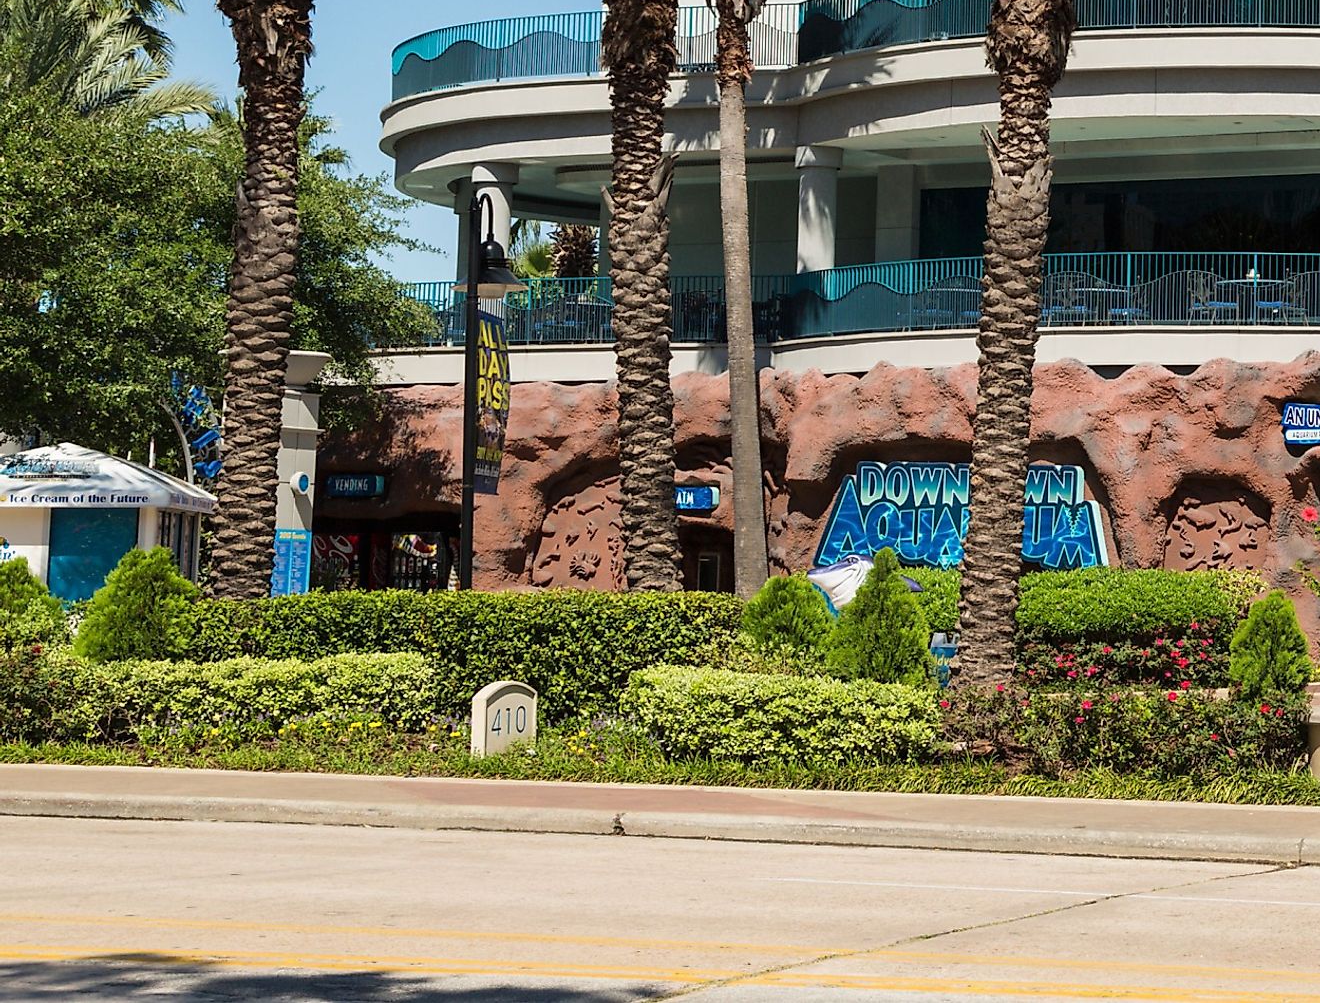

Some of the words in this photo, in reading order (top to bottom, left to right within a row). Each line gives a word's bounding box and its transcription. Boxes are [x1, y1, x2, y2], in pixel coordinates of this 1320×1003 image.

[478, 319, 508, 351] ALL
[478, 348, 509, 380] DAY
[477, 377, 510, 411] PASS
[1286, 405, 1304, 425] AN
[10, 494, 27, 503] Ice
[31, 494, 69, 503] Cream
[73, 494, 84, 503] of
[88, 494, 107, 503] the
[110, 494, 149, 503] Future
[334, 477, 369, 492] VENDING
[675, 490, 695, 505] ATM
[860, 464, 1077, 507] DOWNWN
[818, 478, 1098, 568] AQUAUM
[491, 705, 526, 736] 410
